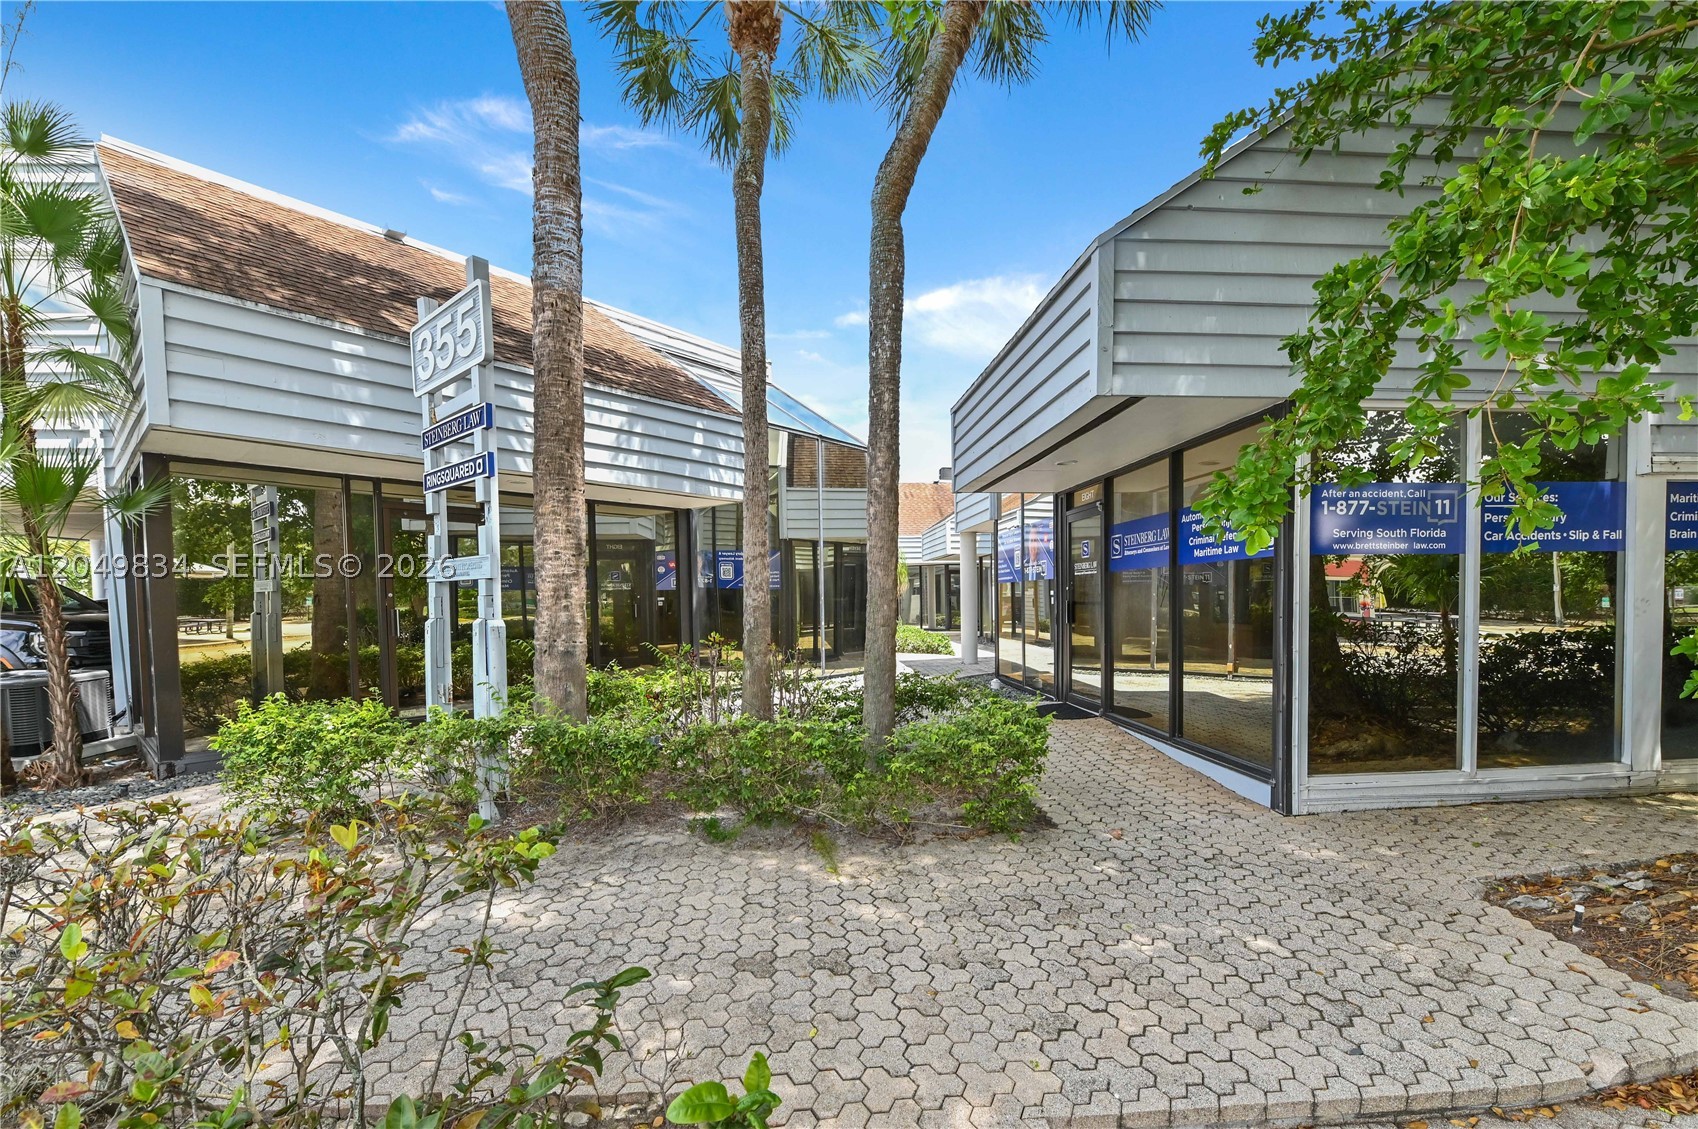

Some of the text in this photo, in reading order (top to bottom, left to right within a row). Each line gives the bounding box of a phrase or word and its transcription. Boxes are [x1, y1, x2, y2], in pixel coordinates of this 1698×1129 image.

[416, 298, 478, 381] 355
[424, 410, 482, 447] STEINBERG LAW
[426, 461, 475, 488] RINGSQUARED
[1081, 490, 1095, 501] EIGHT
[1321, 489, 1347, 498] After
[1348, 490, 1361, 498] an
[1407, 489, 1426, 498] Call
[1484, 494, 1506, 503] Our
[1181, 511, 1204, 523] Autom
[1123, 529, 1157, 547] STEINBERG
[1157, 527, 1169, 541] LAW
[1333, 528, 1447, 540] Serving South Florida
[1484, 531, 1504, 541] Car
[1569, 529, 1590, 542] Slip
[1592, 530, 1600, 540] &
[1603, 530, 1622, 540] Fall
[1670, 528, 1697, 539] Brain
[1188, 535, 1215, 547] Criminal
[1194, 545, 1240, 558] Maritime Law
